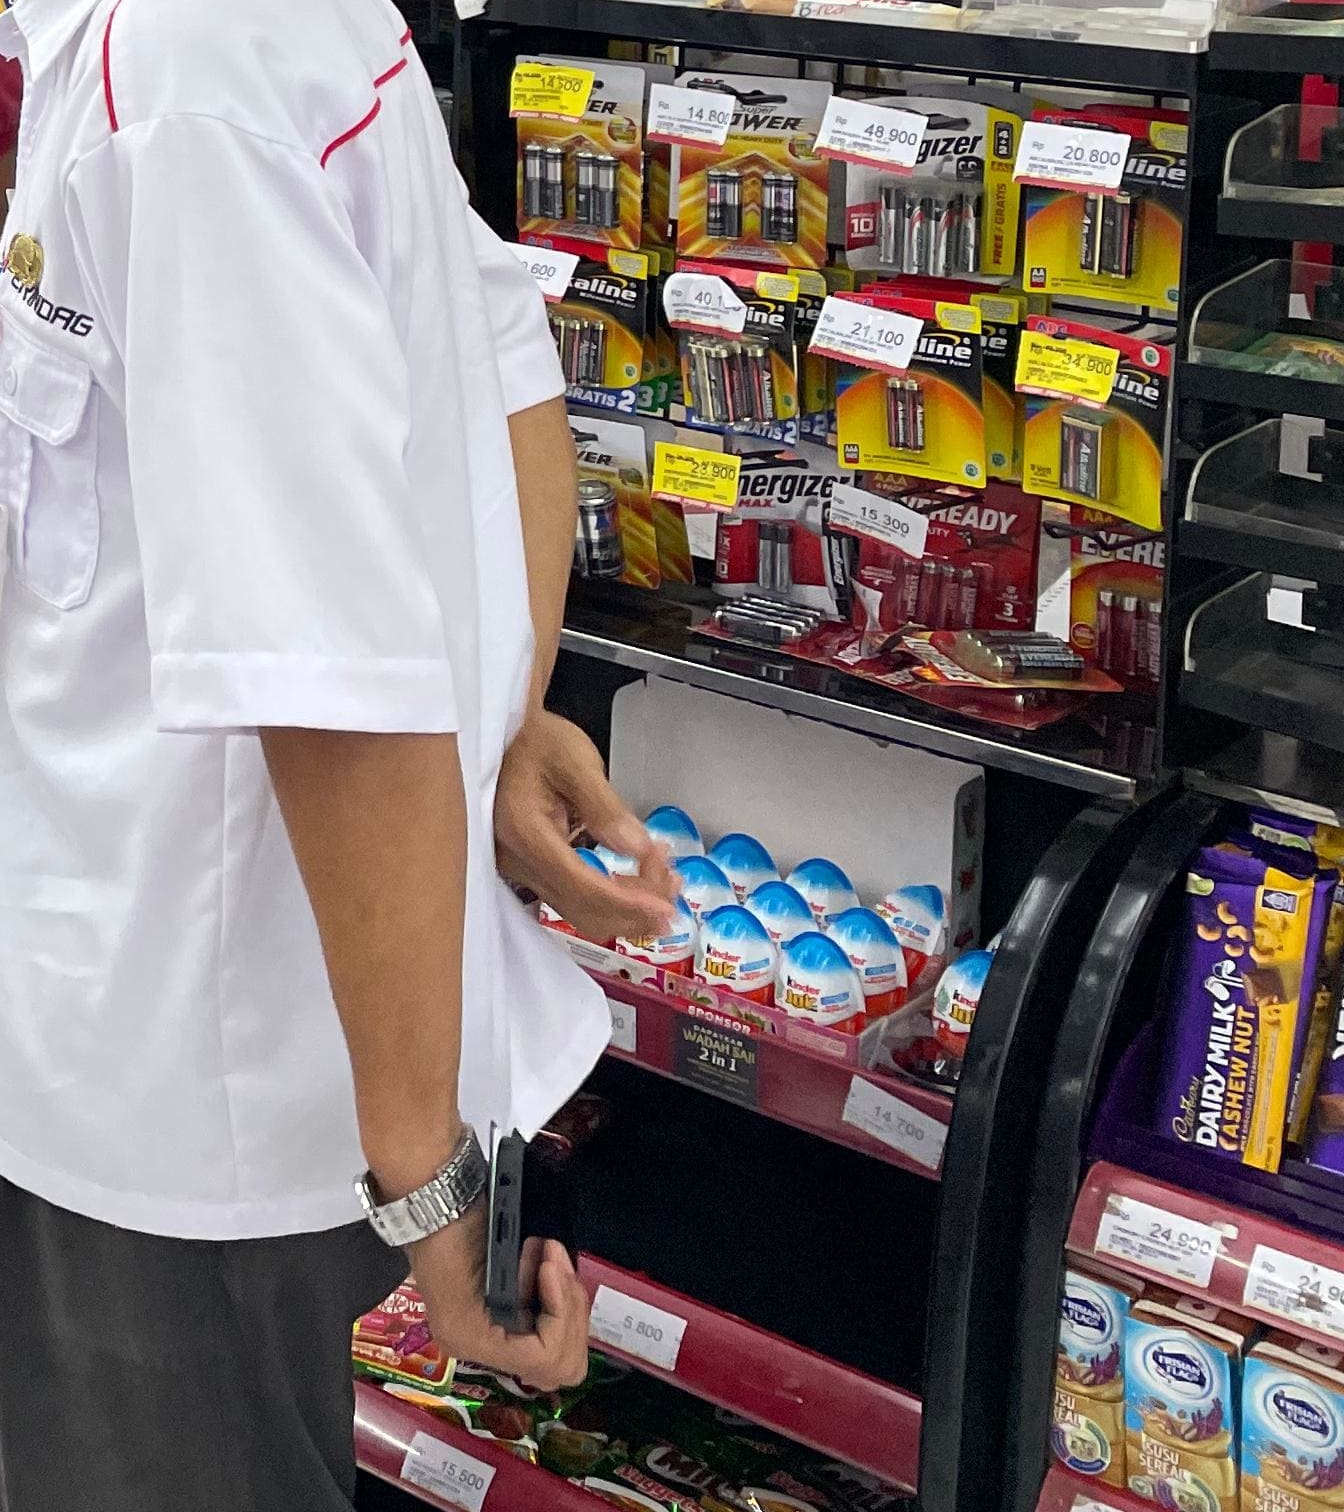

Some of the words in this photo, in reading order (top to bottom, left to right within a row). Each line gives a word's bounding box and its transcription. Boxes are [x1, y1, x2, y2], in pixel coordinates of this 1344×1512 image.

[657, 100, 670, 110] Rp
[835, 115, 847, 126] Rp
[1031, 141, 1045, 151] Rp
[994, 183, 1007, 218] GRATIS
[849, 218, 876, 236] 10
[992, 235, 1003, 265] FREE
[1031, 267, 1046, 276] AA
[822, 314, 835, 324] Rp
[615, 389, 637, 411] 2
[844, 444, 860, 454] AAA
[873, 472, 908, 487] AAA
[739, 497, 774, 508] MAX
[687, 1005, 752, 1035] SPONSOR
[1233, 1004, 1257, 1054] NUT
[682, 1027, 730, 1055] WADAH
[698, 1047, 710, 1061] 2
[712, 1053, 726, 1067] in
[728, 1057, 737, 1072] 1
[1194, 1059, 1222, 1148] DAIRY
[1209, 1002, 1237, 1061] MILK
[1171, 1073, 1200, 1143] Cadbury
[1219, 1052, 1249, 1153] CASHEW
[1262, 1260, 1276, 1273] Rp
[1157, 1348, 1208, 1376] FRISIAN
[1164, 1364, 1207, 1388] FLAG
[1279, 1396, 1330, 1424] FRISIAN
[1287, 1409, 1329, 1435] FLAG
[1144, 1440, 1180, 1465] SUSU
[1138, 1453, 1187, 1481] SEREAL
[1262, 1486, 1300, 1509] SUSU
